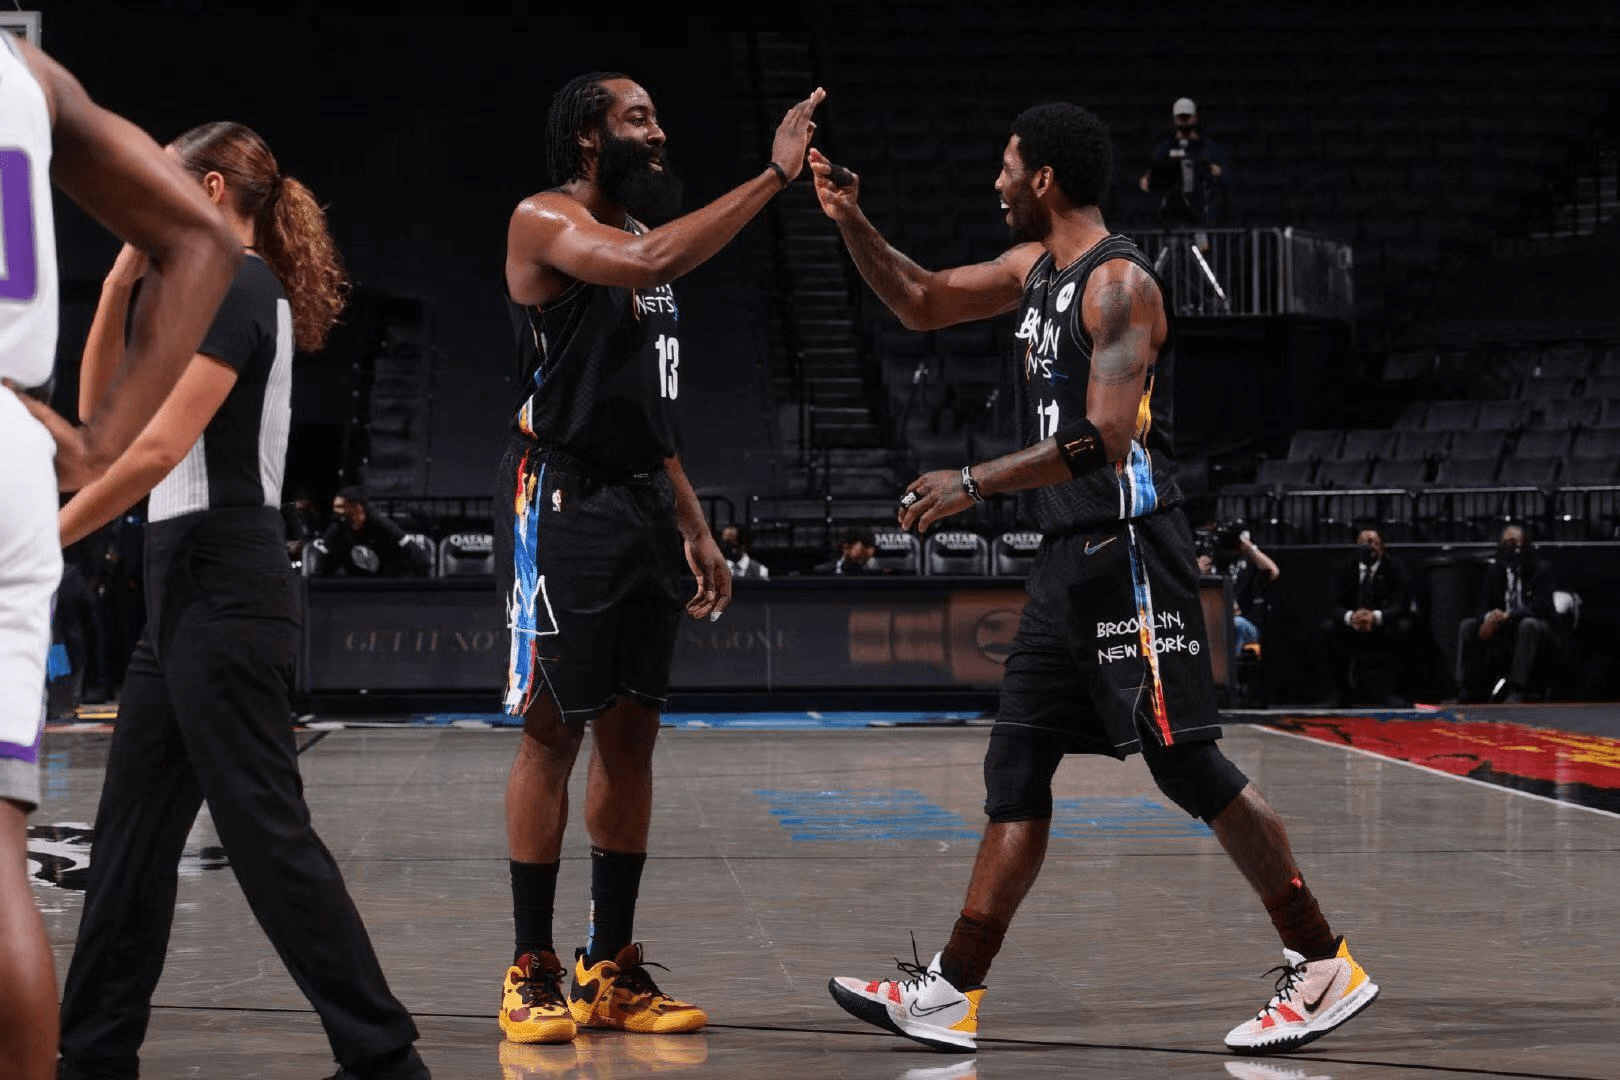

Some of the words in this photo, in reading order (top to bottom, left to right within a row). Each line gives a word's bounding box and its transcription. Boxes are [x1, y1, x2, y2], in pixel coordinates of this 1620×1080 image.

[635, 294, 675, 315] NETS
[1015, 307, 1061, 360] BKYN
[655, 334, 679, 400] 13
[450, 534, 493, 547] QATAR
[935, 532, 978, 545] QATAR
[452, 630, 500, 653] NO
[1098, 644, 1138, 665] NEW
